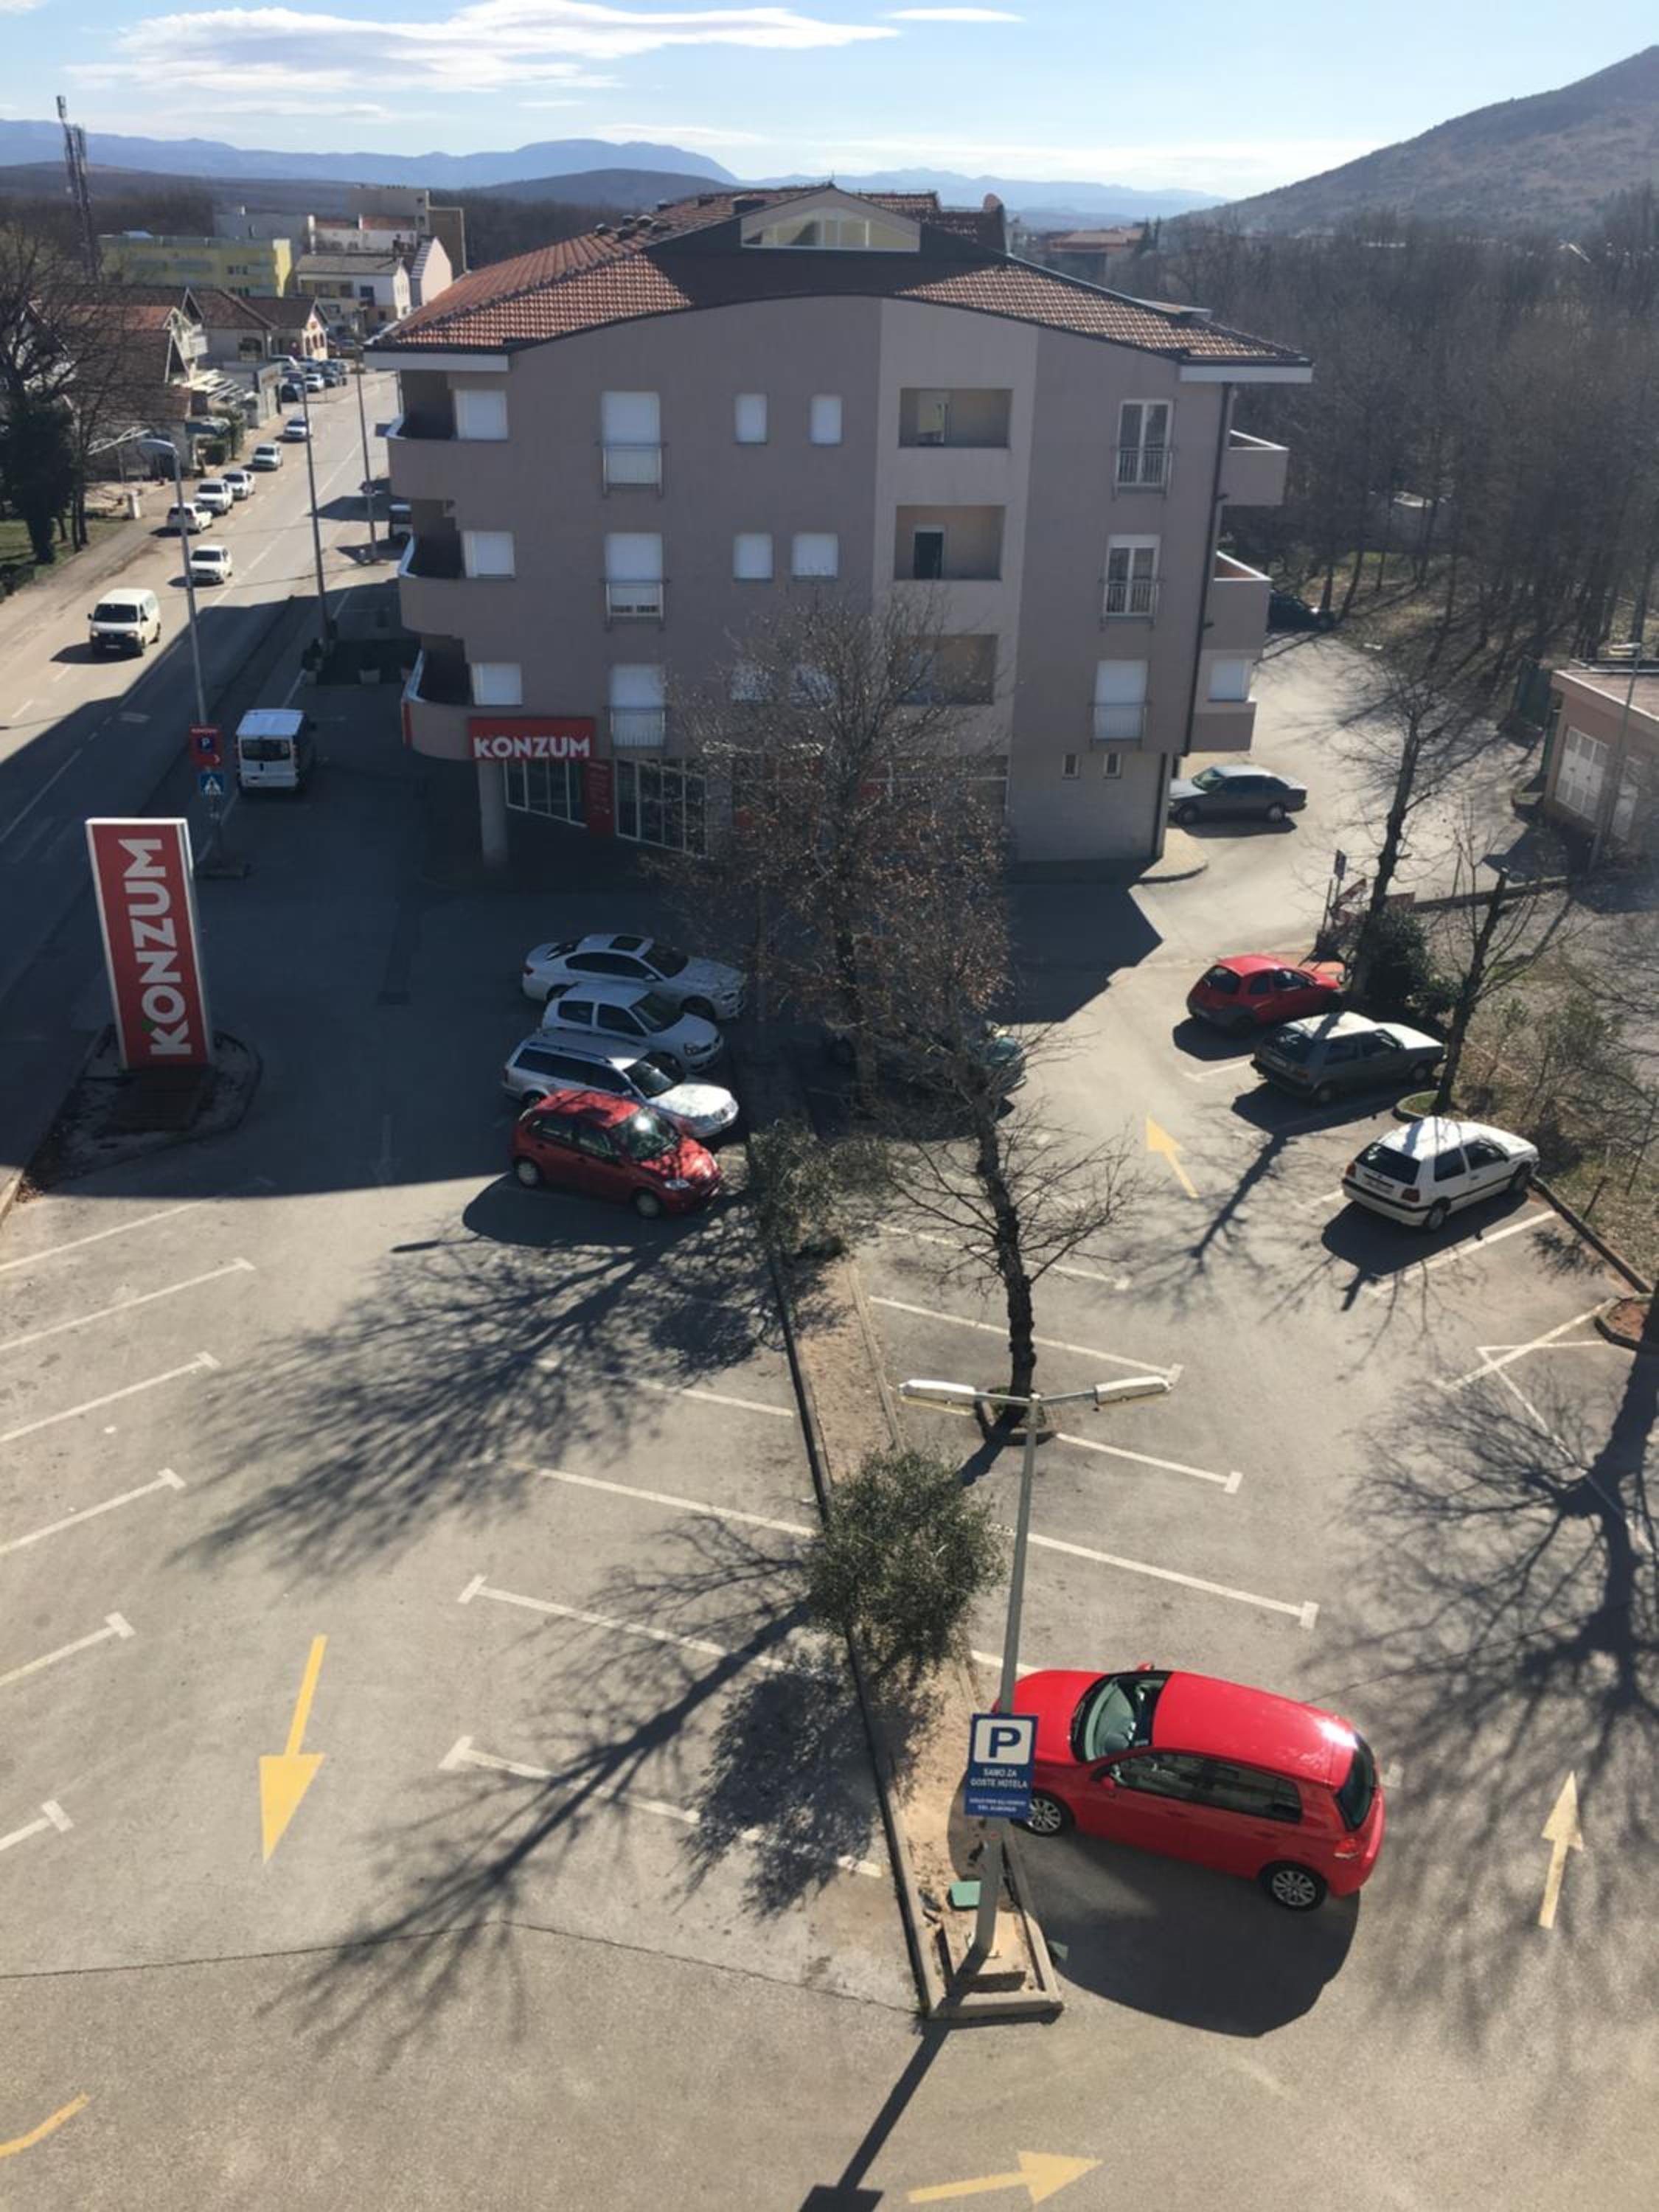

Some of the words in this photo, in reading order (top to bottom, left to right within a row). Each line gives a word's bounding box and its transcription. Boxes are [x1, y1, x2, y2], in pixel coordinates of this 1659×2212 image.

[473, 736, 591, 758] KONZUM
[118, 838, 192, 1056] KONZUM
[989, 1726, 1020, 1758] P
[998, 1779, 1027, 1789] HOTELA
[1006, 1769, 1017, 1778] ZA
